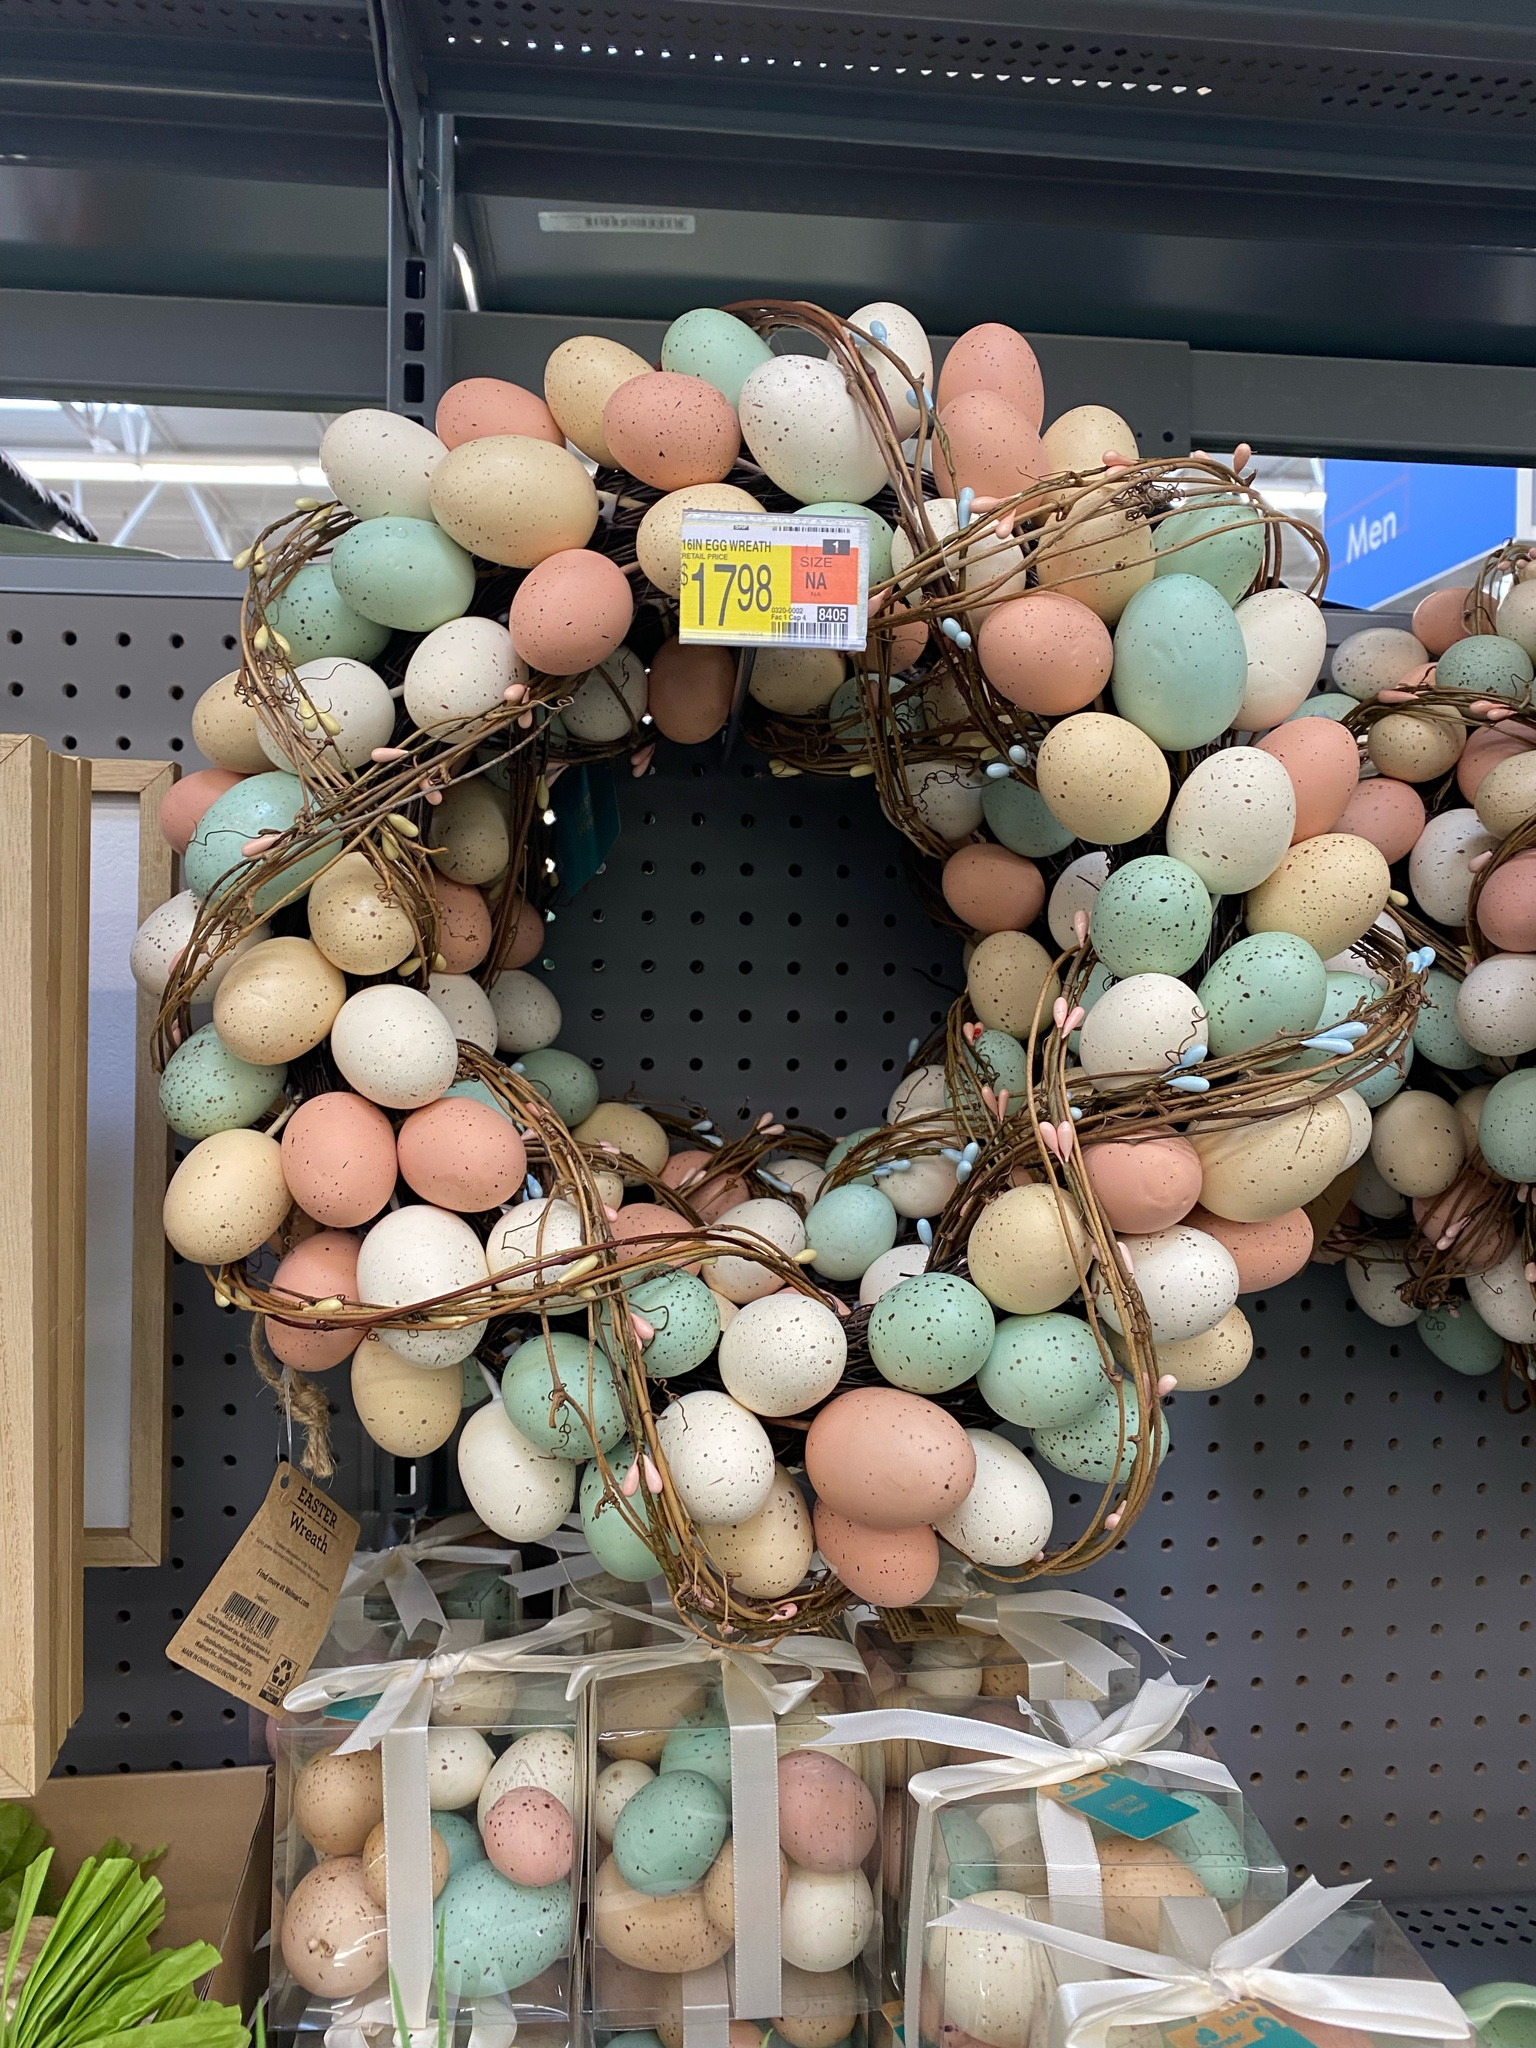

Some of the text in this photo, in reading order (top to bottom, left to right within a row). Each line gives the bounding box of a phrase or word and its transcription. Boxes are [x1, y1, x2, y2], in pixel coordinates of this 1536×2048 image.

[1346, 511, 1397, 564] Men
[682, 538, 772, 553] 16IN EGG WREATH
[832, 541, 839, 554] 1
[681, 552, 728, 561] RETAIL PRICE
[800, 556, 833, 568] SIZE
[805, 571, 828, 590] NA
[789, 614, 801, 622] Cap
[818, 607, 847, 622] 8405
[297, 1486, 338, 1529] EASTER
[290, 1510, 328, 1554] Wreath
[257, 1568, 270, 1580] Find
[267, 1576, 281, 1588] more
[279, 1584, 287, 1592] at
